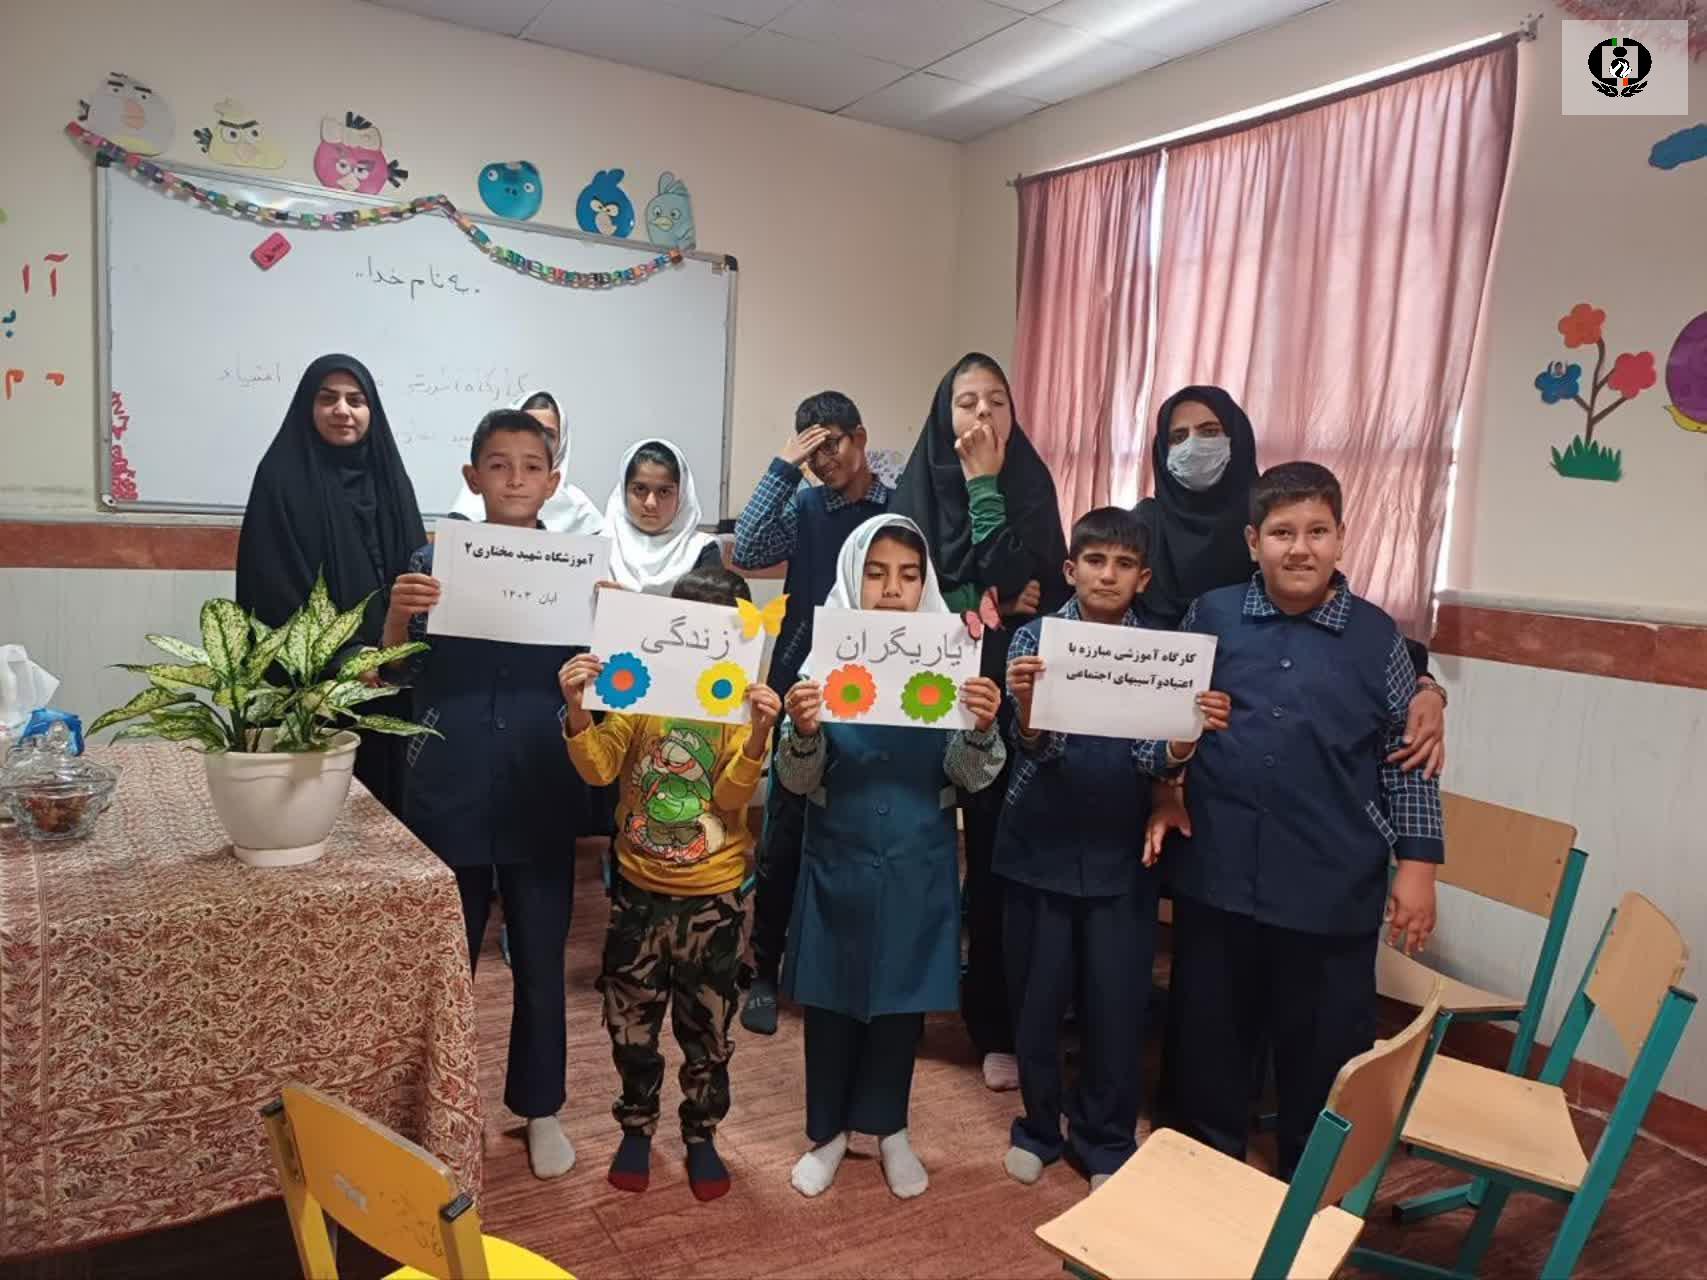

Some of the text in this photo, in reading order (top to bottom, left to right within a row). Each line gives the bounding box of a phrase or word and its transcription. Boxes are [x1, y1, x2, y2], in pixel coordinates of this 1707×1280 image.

[516, 549, 543, 564] شهید
[544, 551, 594, 568] آموزشگاه
[641, 615, 729, 661] زندگی
[835, 625, 963, 668] یاریگران
[1068, 641, 1198, 667] کارگاه آموزشی مبارزه با
[1065, 669, 1112, 684] اجتماعی
